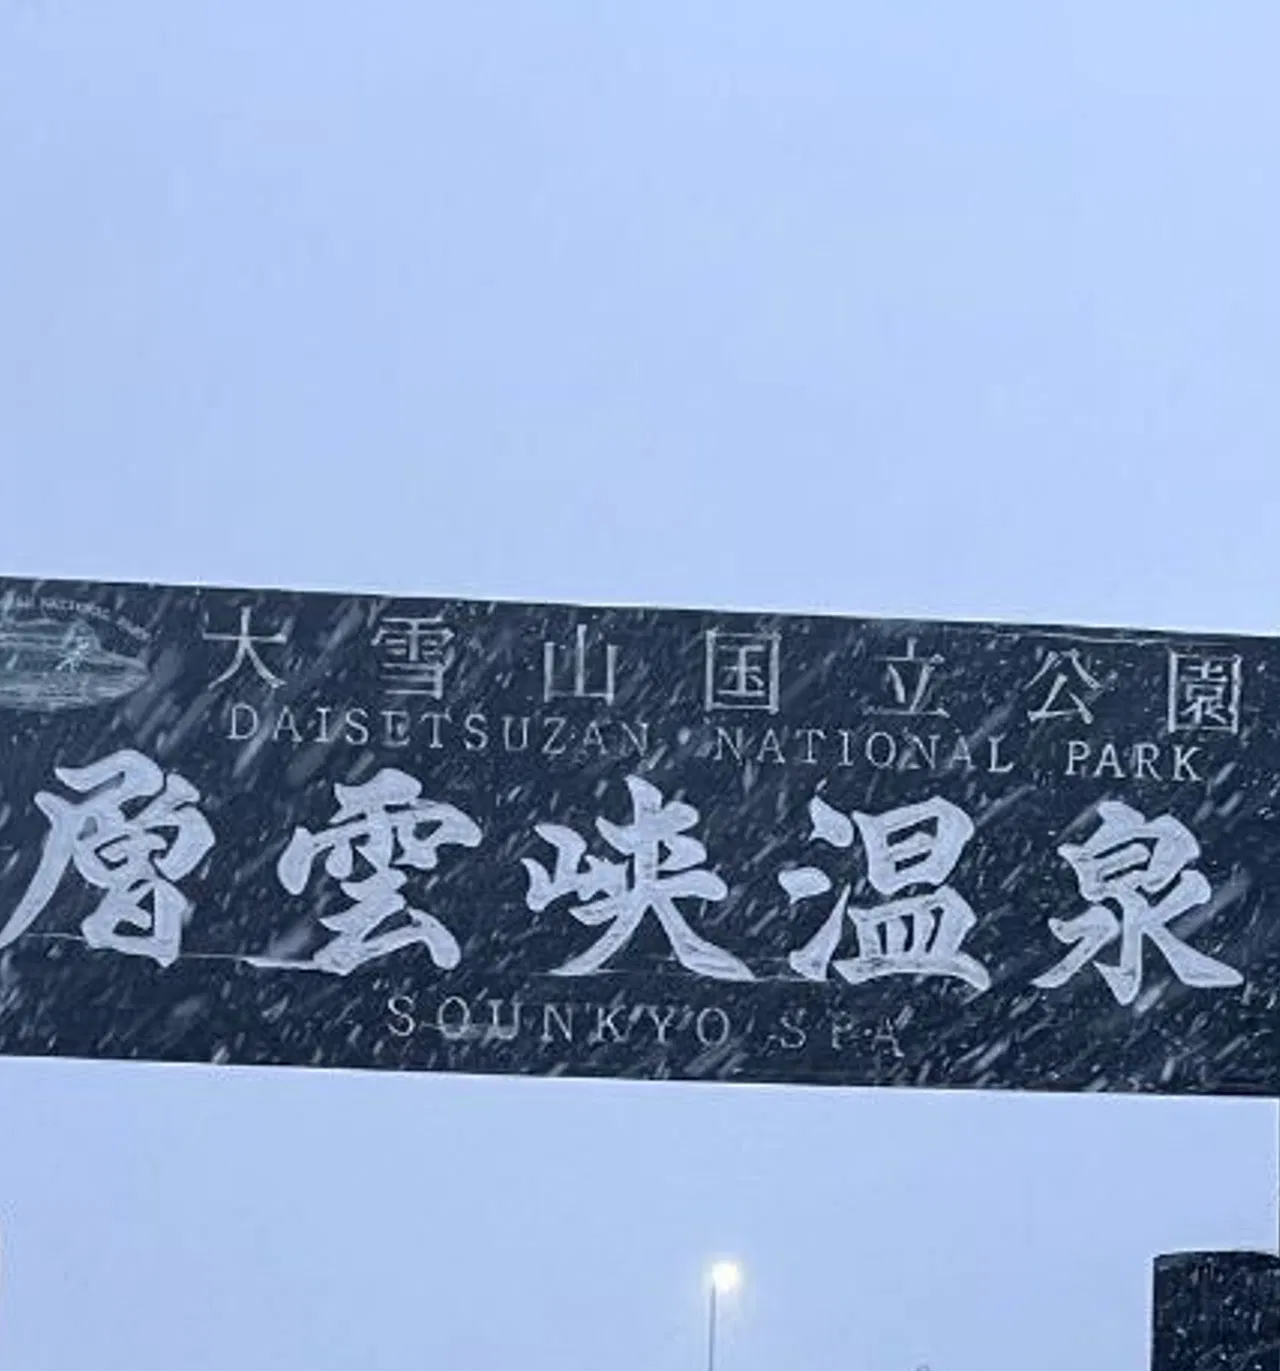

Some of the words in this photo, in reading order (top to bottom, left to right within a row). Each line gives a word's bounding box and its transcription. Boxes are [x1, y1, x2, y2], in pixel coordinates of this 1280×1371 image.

[200, 605, 1244, 734] 大雪山国立公園
[226, 702, 650, 758] DAISETSUZAN
[714, 724, 1014, 773] NATIONAL
[1064, 739, 1204, 783] PARK
[387, 996, 731, 1048] SOUNKYO
[780, 1008, 906, 1058] SPA
